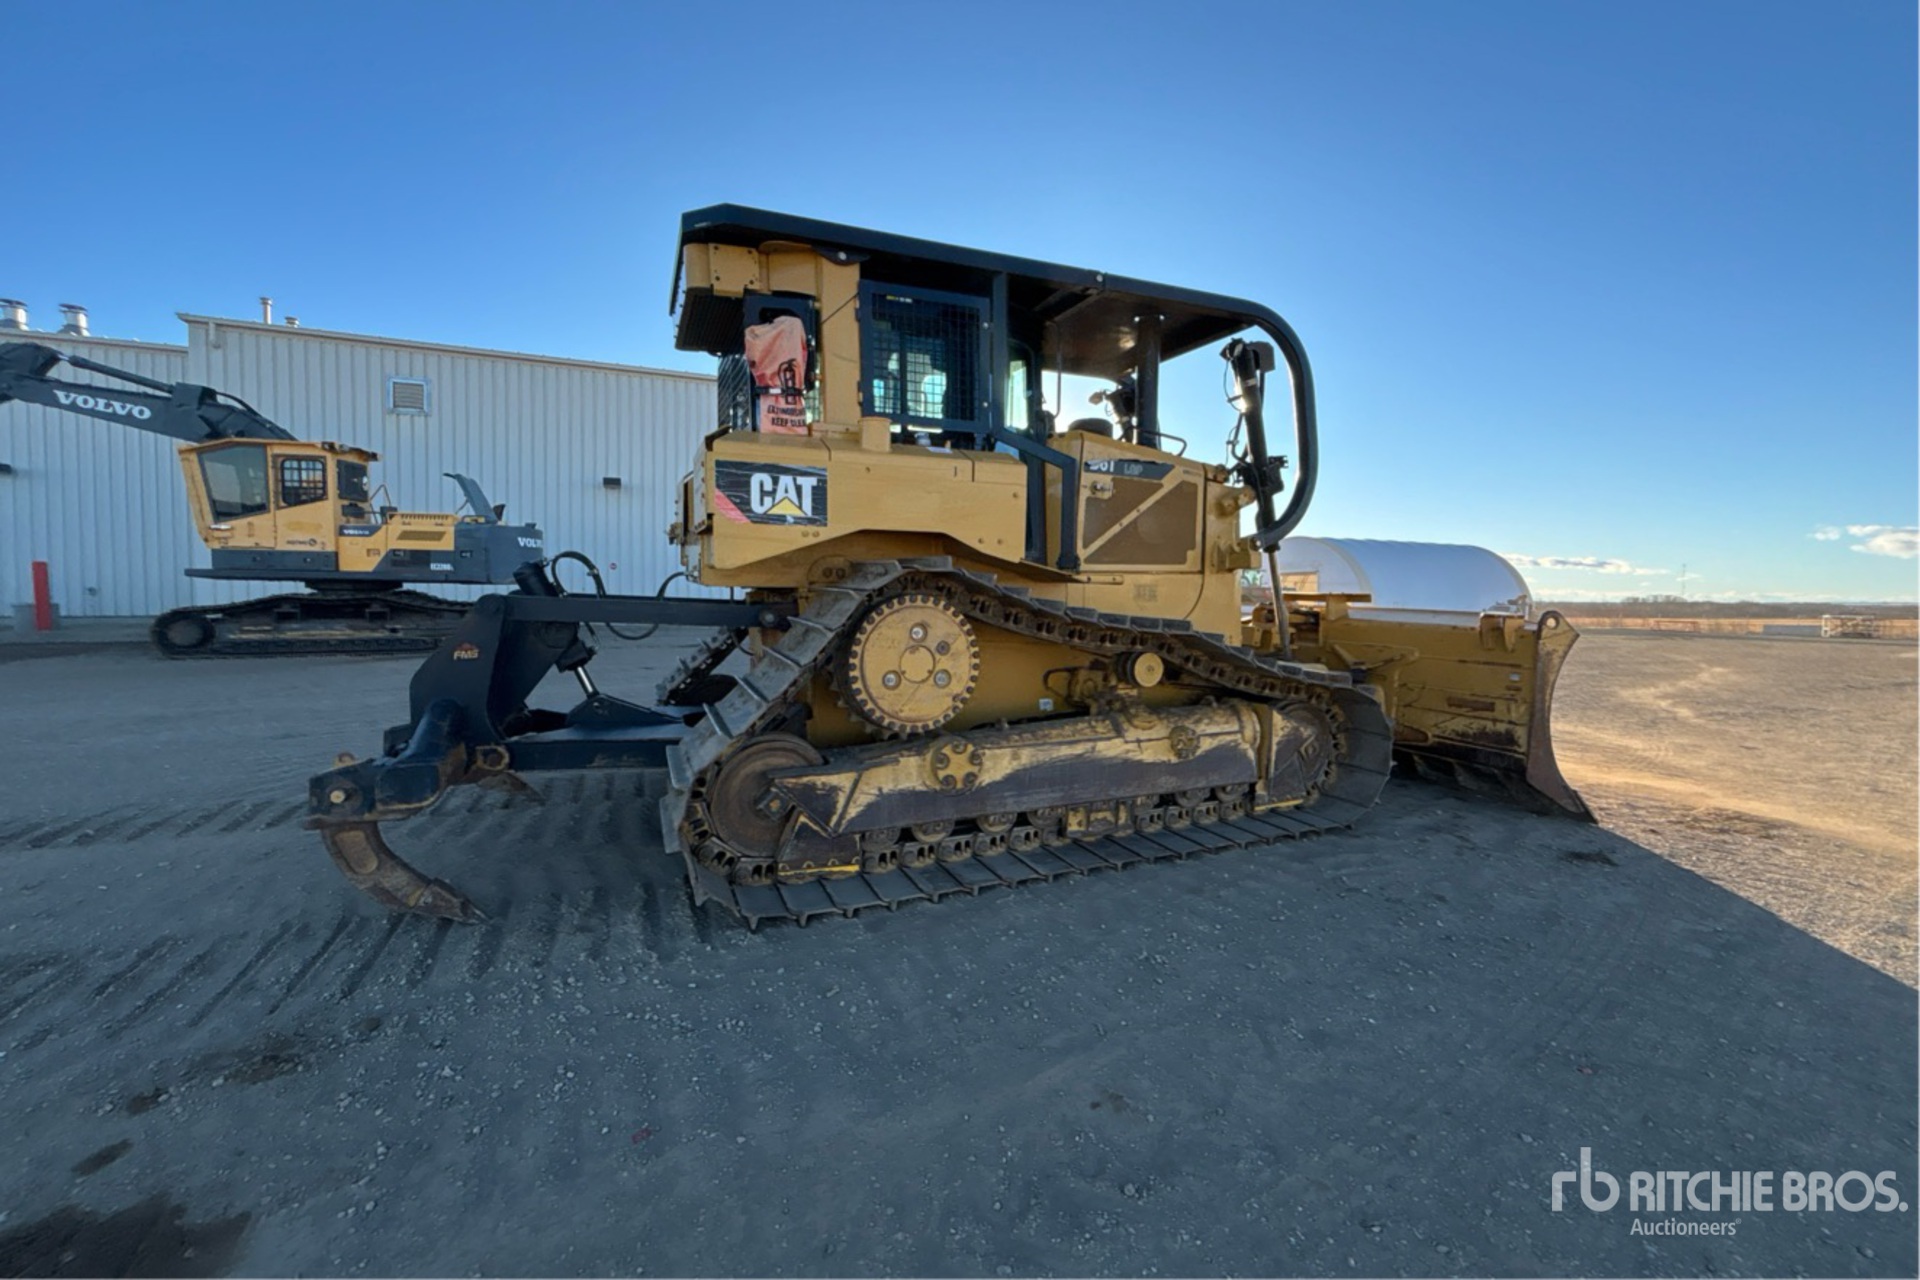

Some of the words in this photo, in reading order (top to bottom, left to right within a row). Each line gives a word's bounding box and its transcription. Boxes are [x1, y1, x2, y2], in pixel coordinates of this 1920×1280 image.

[52, 389, 152, 419] VOLVO
[771, 417, 789, 427] KEEP
[750, 472, 818, 517] CAT
[517, 536, 543, 548] VOLV
[453, 649, 479, 660] FMS
